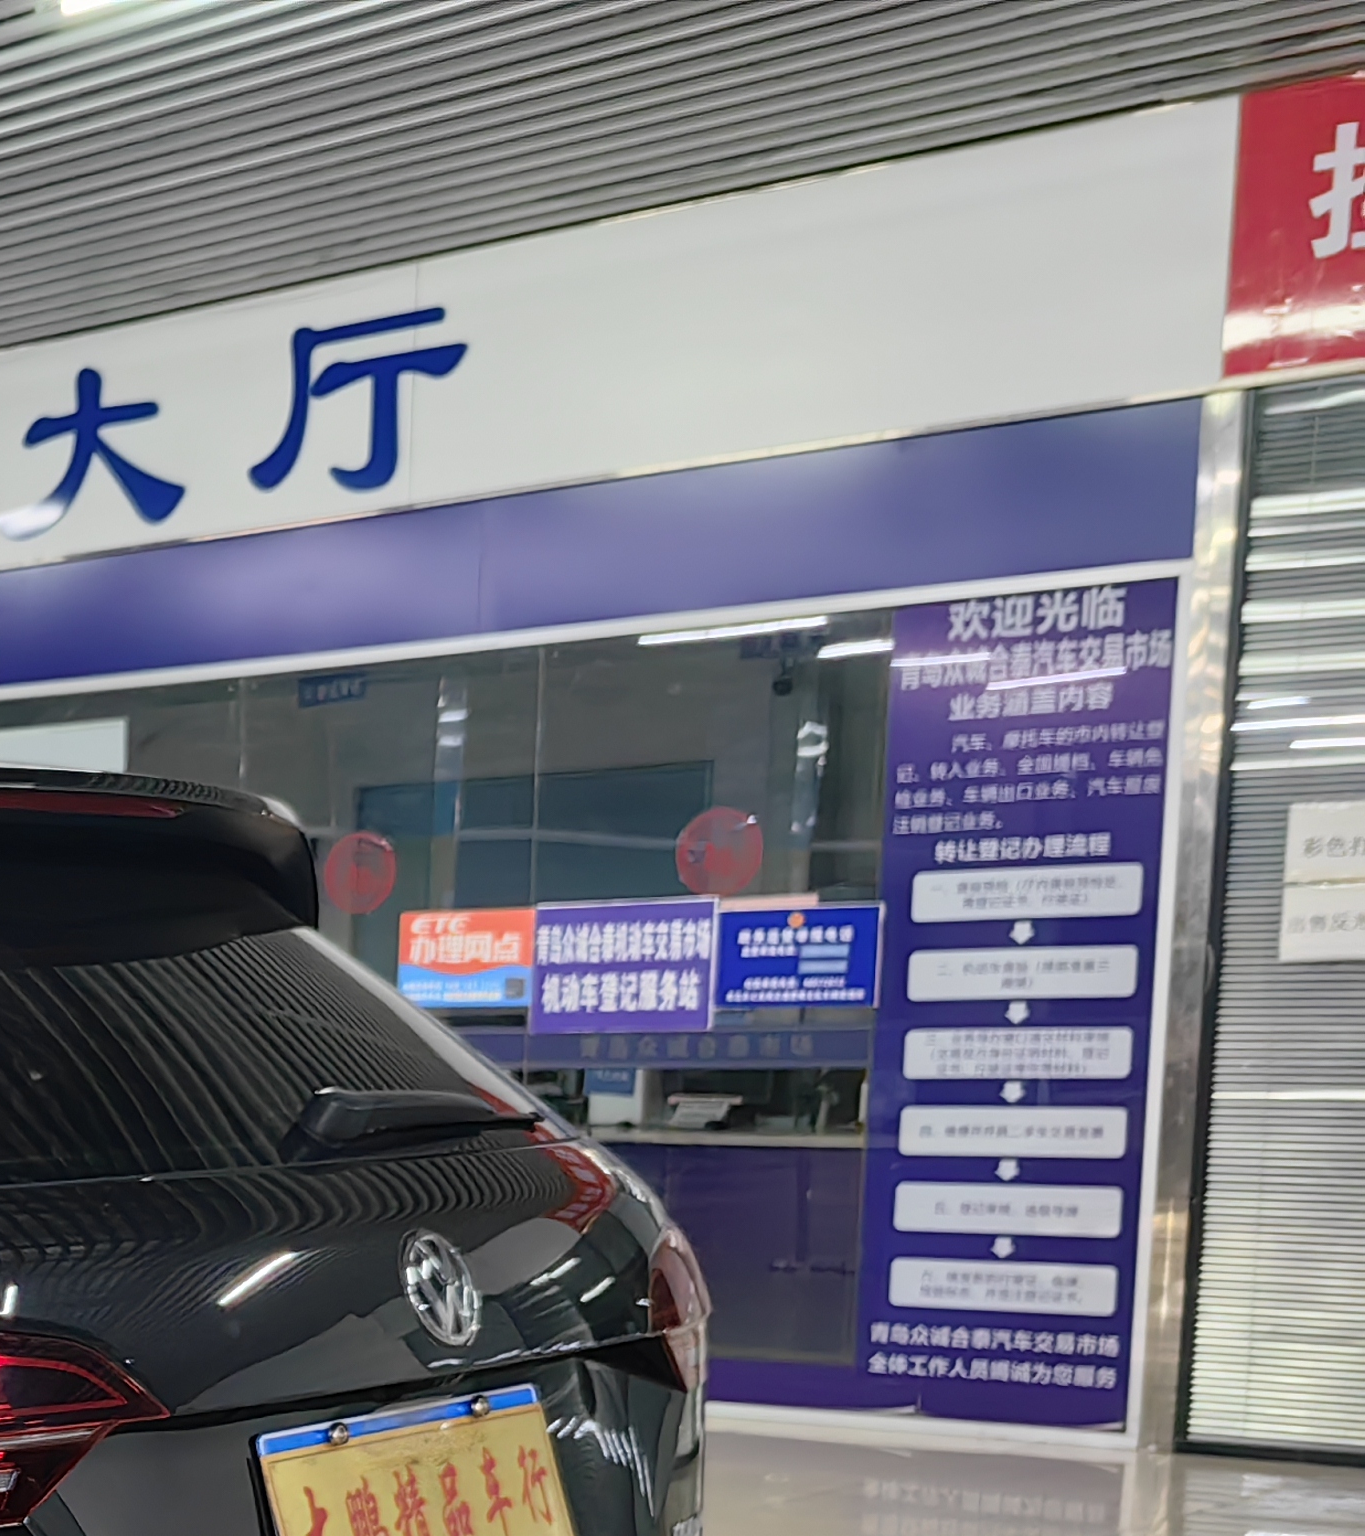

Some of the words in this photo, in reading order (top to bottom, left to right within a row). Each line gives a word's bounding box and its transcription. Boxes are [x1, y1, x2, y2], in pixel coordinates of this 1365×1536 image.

[948, 586, 1127, 641] 欢迎光临
[935, 833, 1110, 863] 转让登记办理流程
[412, 915, 470, 934] ETC
[410, 932, 521, 965] 办理网点
[541, 968, 701, 1014] 机动车登记服务站
